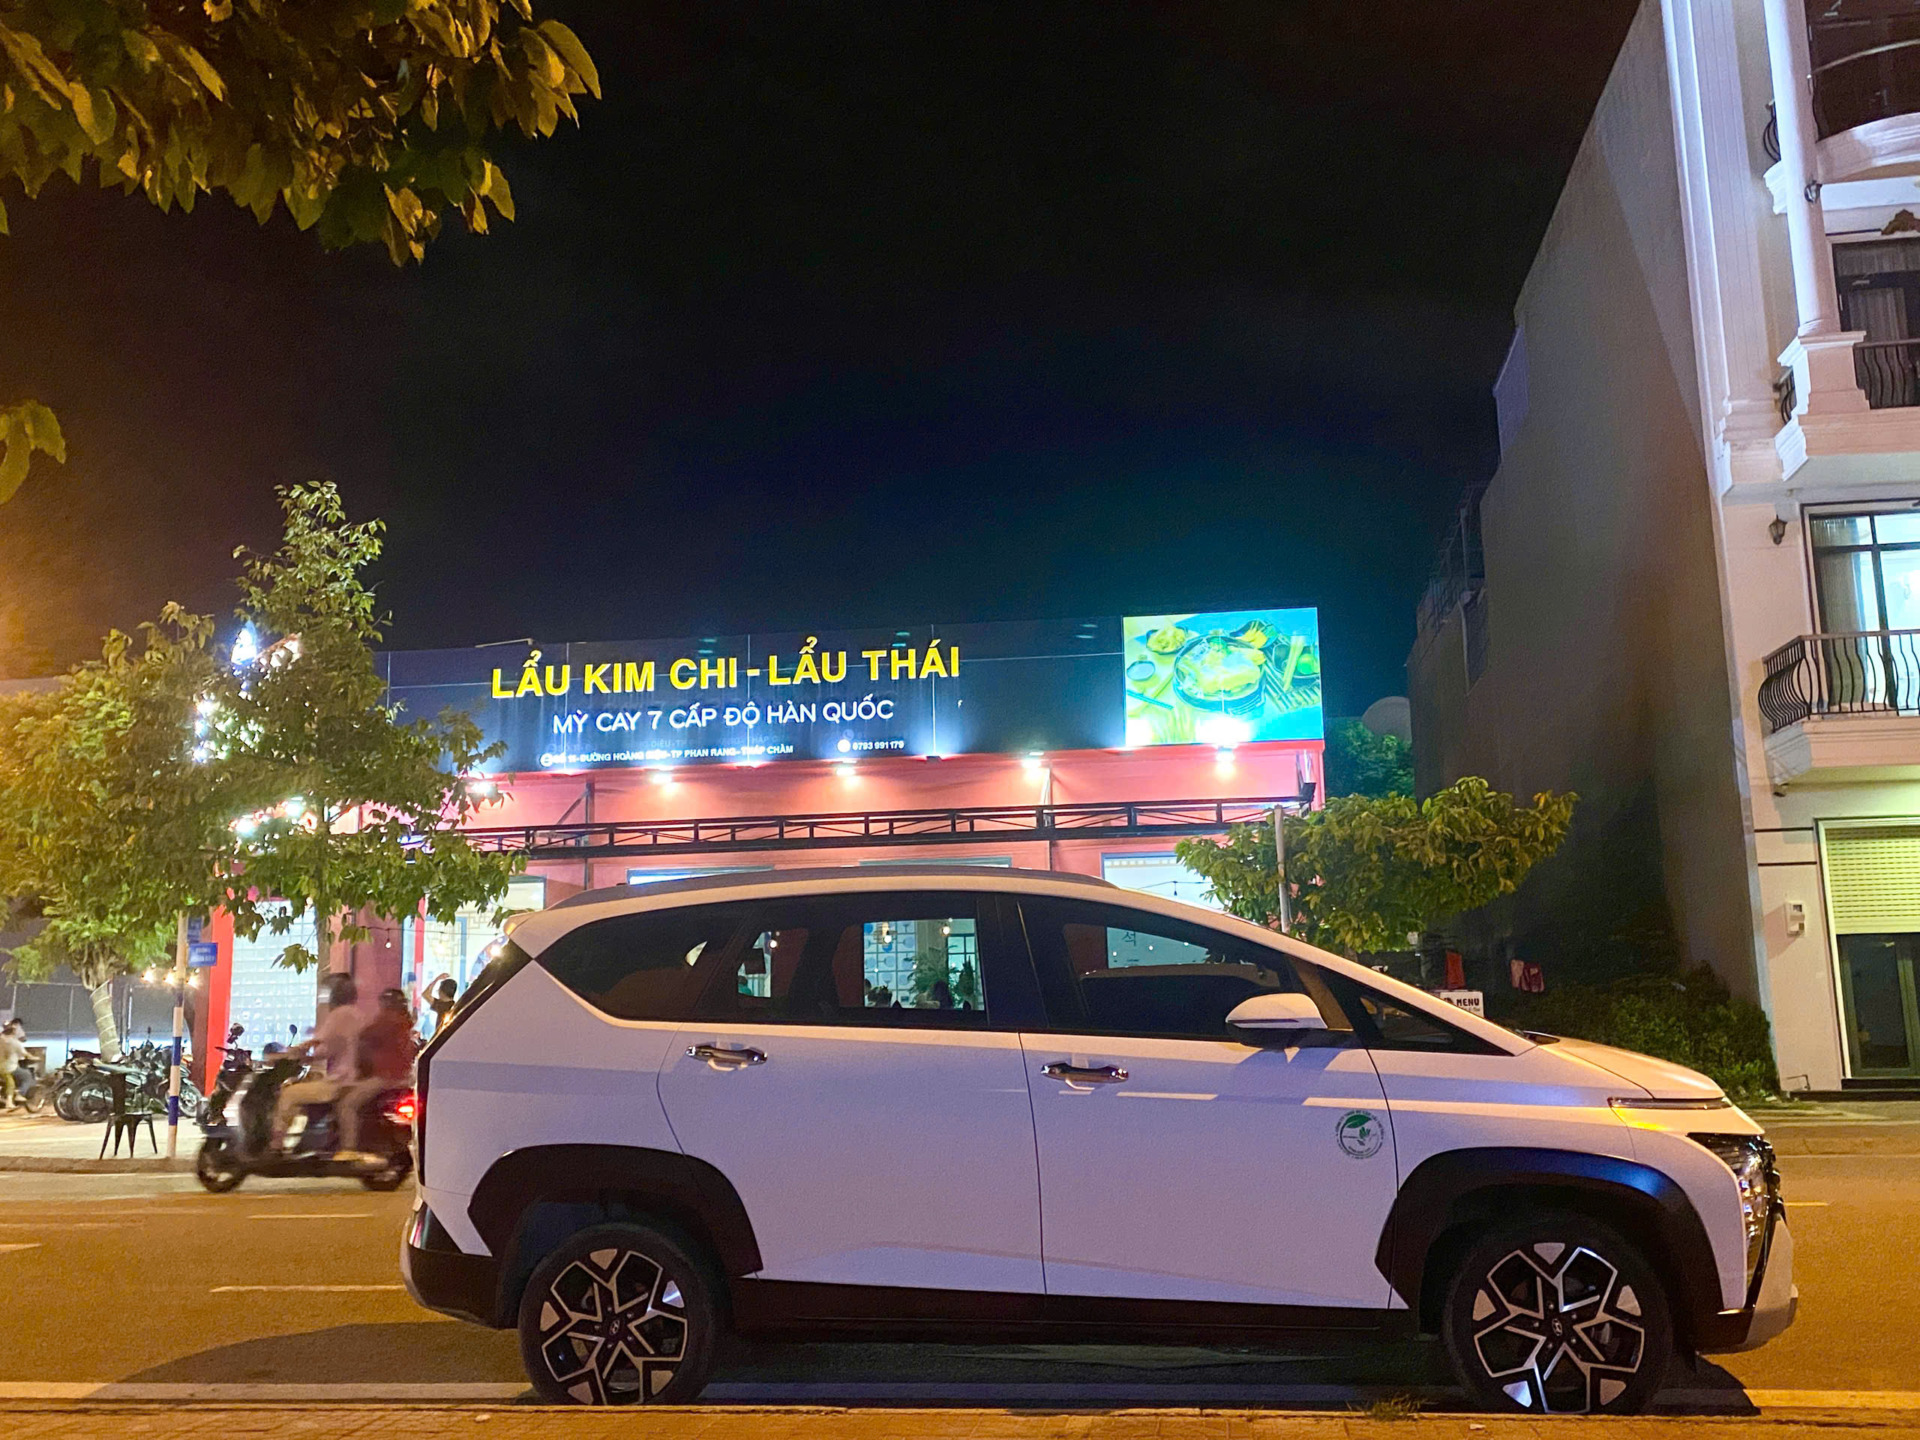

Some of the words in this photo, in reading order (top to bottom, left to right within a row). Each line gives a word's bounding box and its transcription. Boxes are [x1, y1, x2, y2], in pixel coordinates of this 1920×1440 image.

[491, 649, 570, 698] LẨU
[584, 661, 655, 695] KIM
[669, 657, 737, 690] CHI
[746, 668, 760, 677] -
[768, 636, 847, 685] LẨU
[861, 638, 960, 681] THÁI
[553, 709, 588, 734] MỲ
[595, 711, 641, 732] CAY
[647, 710, 663, 730] 7
[669, 702, 717, 729] CẤP
[723, 701, 760, 729] ĐỘ
[766, 700, 816, 724] HÀN
[822, 693, 894, 724] QUỐC
[684, 748, 709, 758] PHAN
[766, 743, 794, 754] CHÀM
[1456, 997, 1480, 1007] MENU
